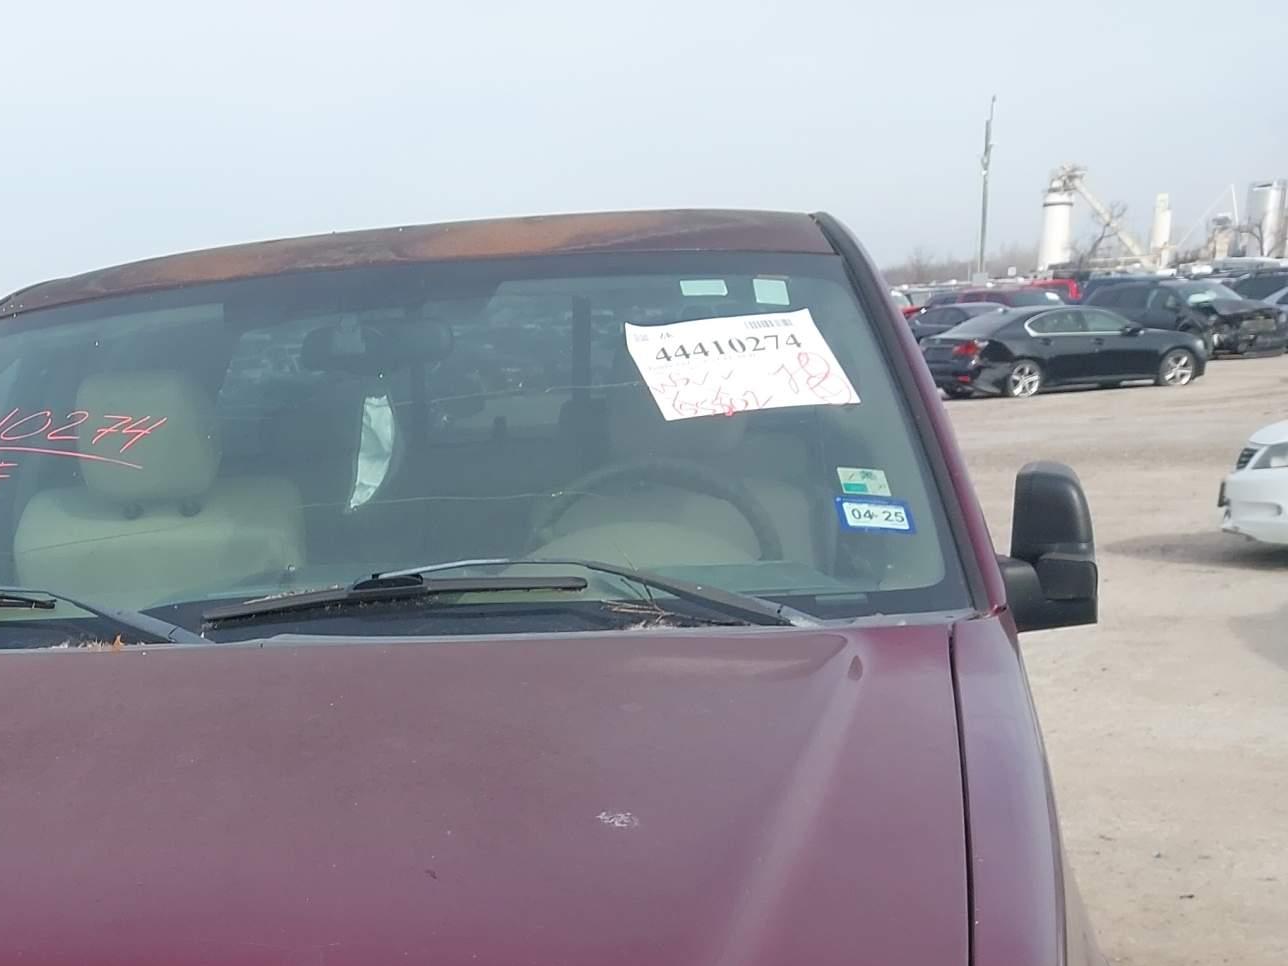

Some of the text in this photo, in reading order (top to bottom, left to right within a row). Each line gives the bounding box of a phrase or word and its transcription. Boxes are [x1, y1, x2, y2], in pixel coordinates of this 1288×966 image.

[655, 332, 803, 363] 44410274
[850, 508, 905, 523] 04 25
